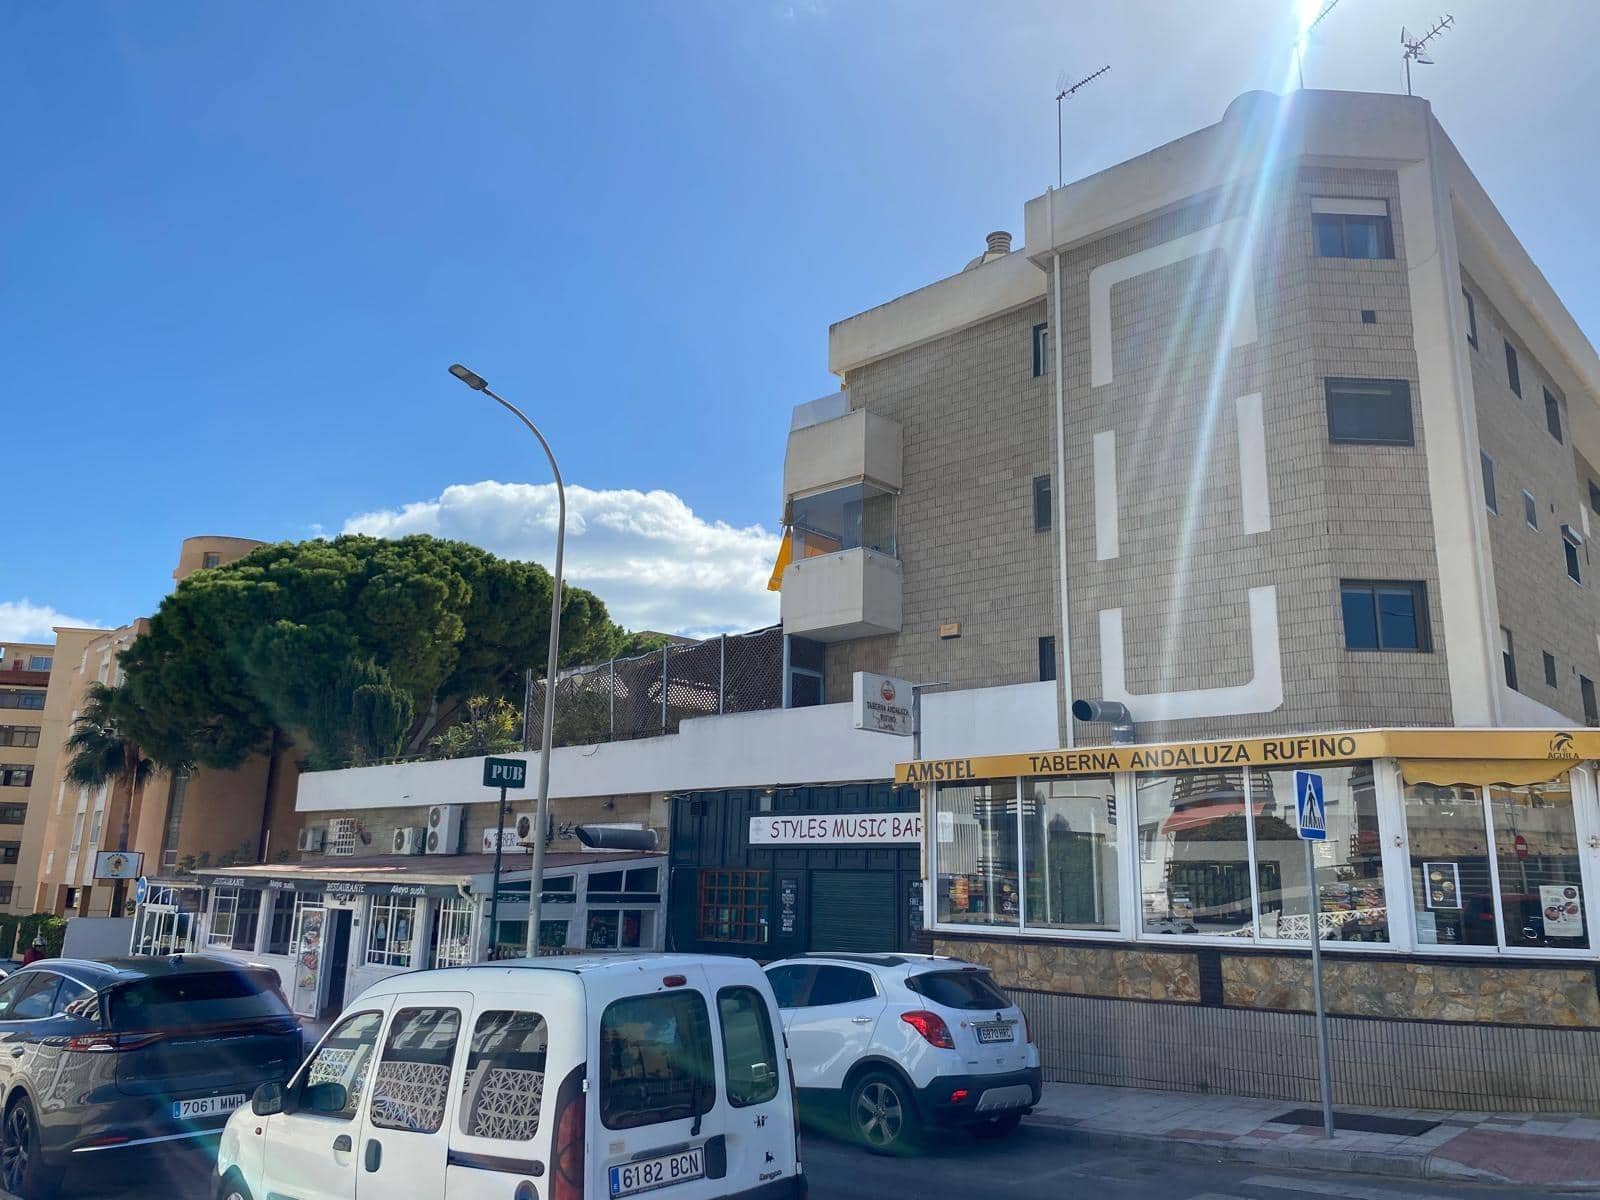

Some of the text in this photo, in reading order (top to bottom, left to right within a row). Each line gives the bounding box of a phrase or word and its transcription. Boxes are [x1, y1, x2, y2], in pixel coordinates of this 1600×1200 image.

[1029, 736, 1357, 772] TABERNA ANDALUZA RUFINO
[491, 764, 523, 781] PUB
[906, 759, 976, 782] AMSTEL
[770, 818, 828, 839] STYLES
[832, 817, 888, 838] MUSIC
[326, 882, 367, 894] RESTAURANTE
[183, 1095, 244, 1115] 7061 MMH
[623, 1152, 699, 1188] 6182 BCN
